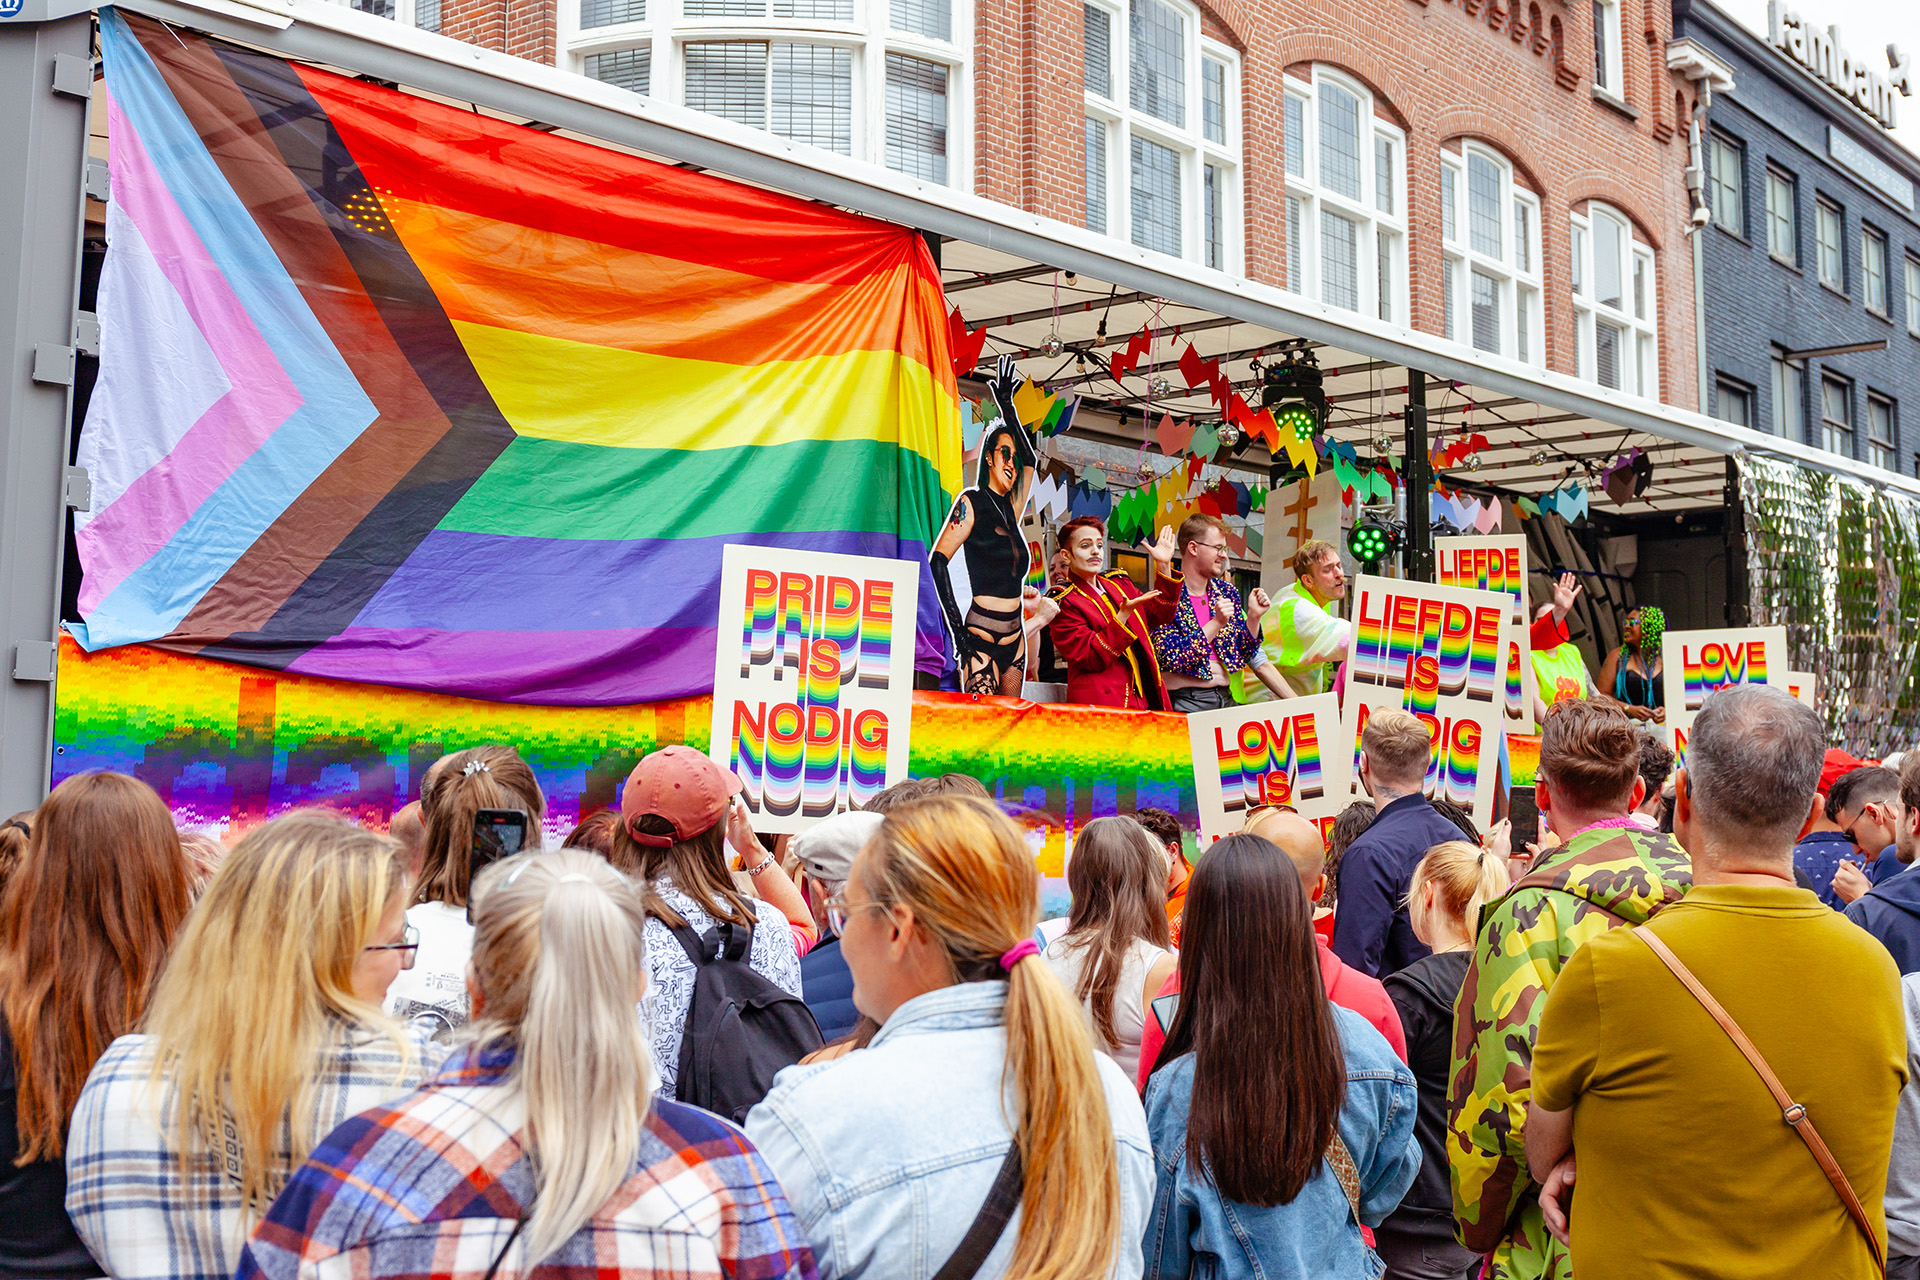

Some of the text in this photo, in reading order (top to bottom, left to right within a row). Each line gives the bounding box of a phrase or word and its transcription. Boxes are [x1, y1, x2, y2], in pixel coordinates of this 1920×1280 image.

[1439, 547, 1520, 578] LIEFDE
[744, 568, 894, 620] PRIDE
[1359, 590, 1501, 642] LIEFDE
[799, 638, 841, 678] IS
[1404, 654, 1440, 691] IS
[1682, 641, 1766, 668] LOVE
[732, 700, 889, 750] NODIG
[1214, 712, 1318, 759] LOVE
[1357, 703, 1482, 753] DIG
[1257, 770, 1291, 805] IS
